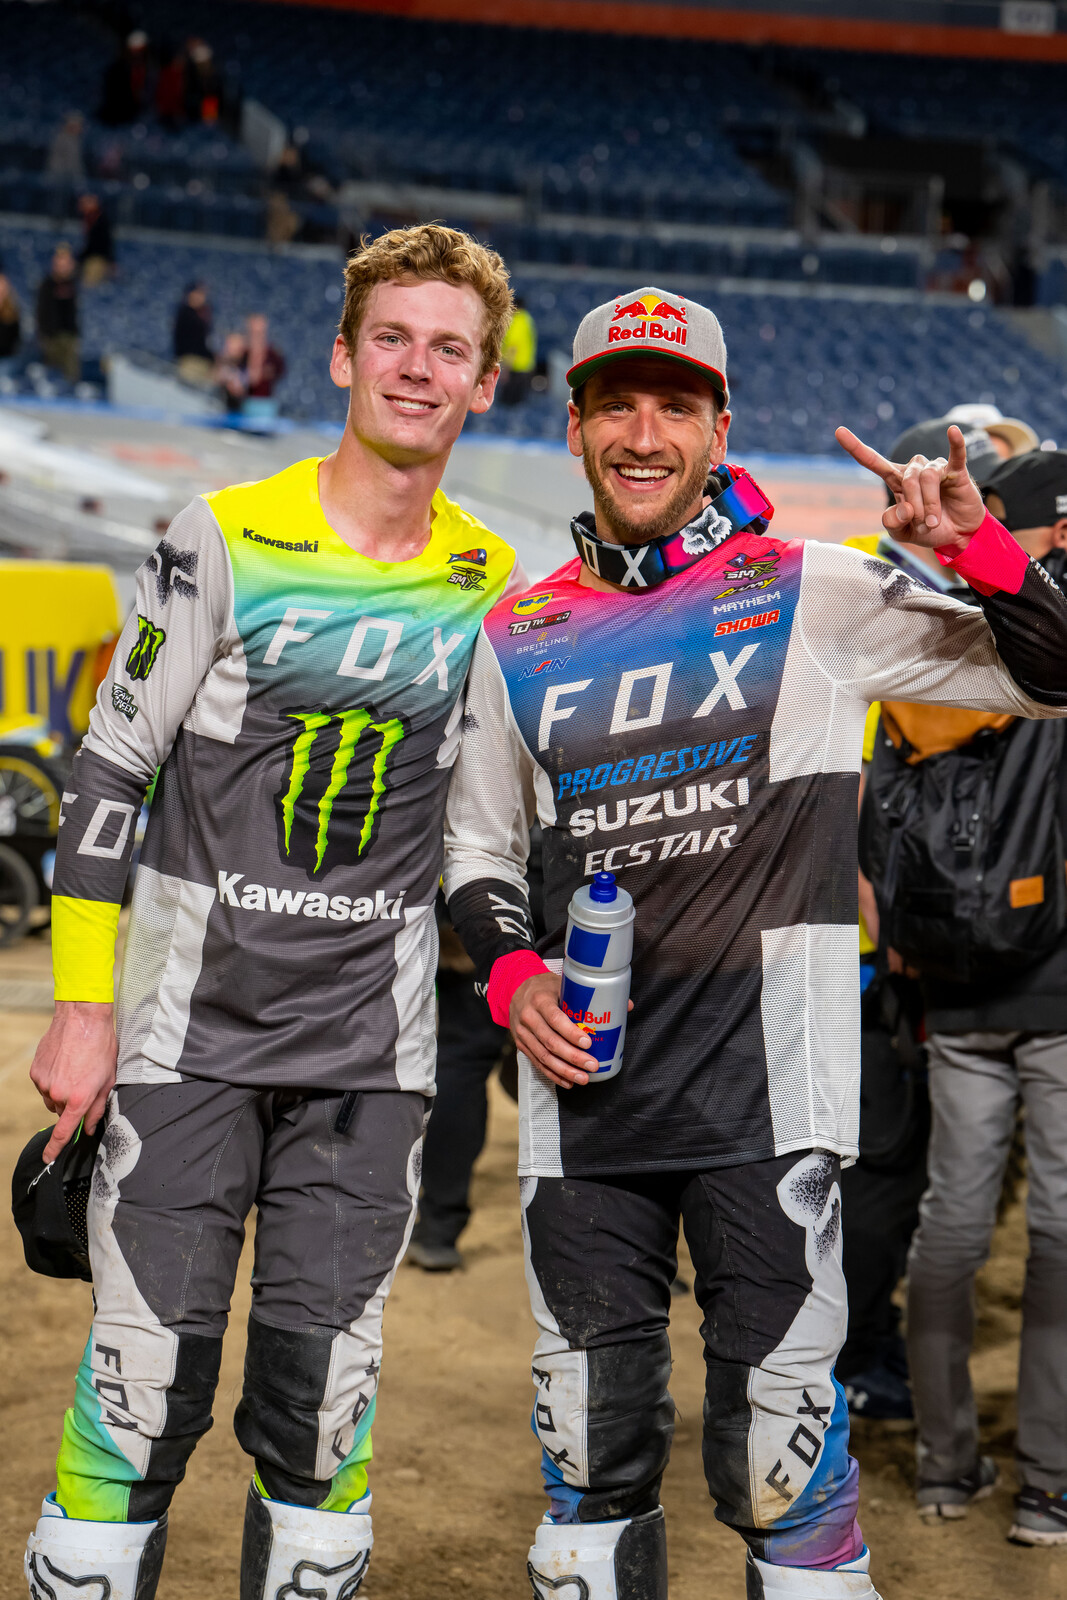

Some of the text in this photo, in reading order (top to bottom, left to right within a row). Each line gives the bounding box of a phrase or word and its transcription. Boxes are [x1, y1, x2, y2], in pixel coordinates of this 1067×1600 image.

[608, 321, 687, 346] Red Bull
[242, 527, 319, 554] Kawasaki
[712, 590, 781, 615] MAYHEM
[713, 609, 780, 637] SHOWA
[263, 607, 466, 691] FOX
[516, 636, 569, 655] BREITLING
[113, 685, 132, 704] TEAM
[538, 642, 761, 752] FOX
[557, 734, 758, 801] PROGRESSIVE
[569, 777, 750, 838] SUZUKI
[583, 824, 742, 876] ECSTAR
[217, 870, 407, 923] Kawasaki
[562, 1000, 611, 1024] Red Bull
[531, 1365, 579, 1483] FOX
[764, 1388, 832, 1503] FOX
